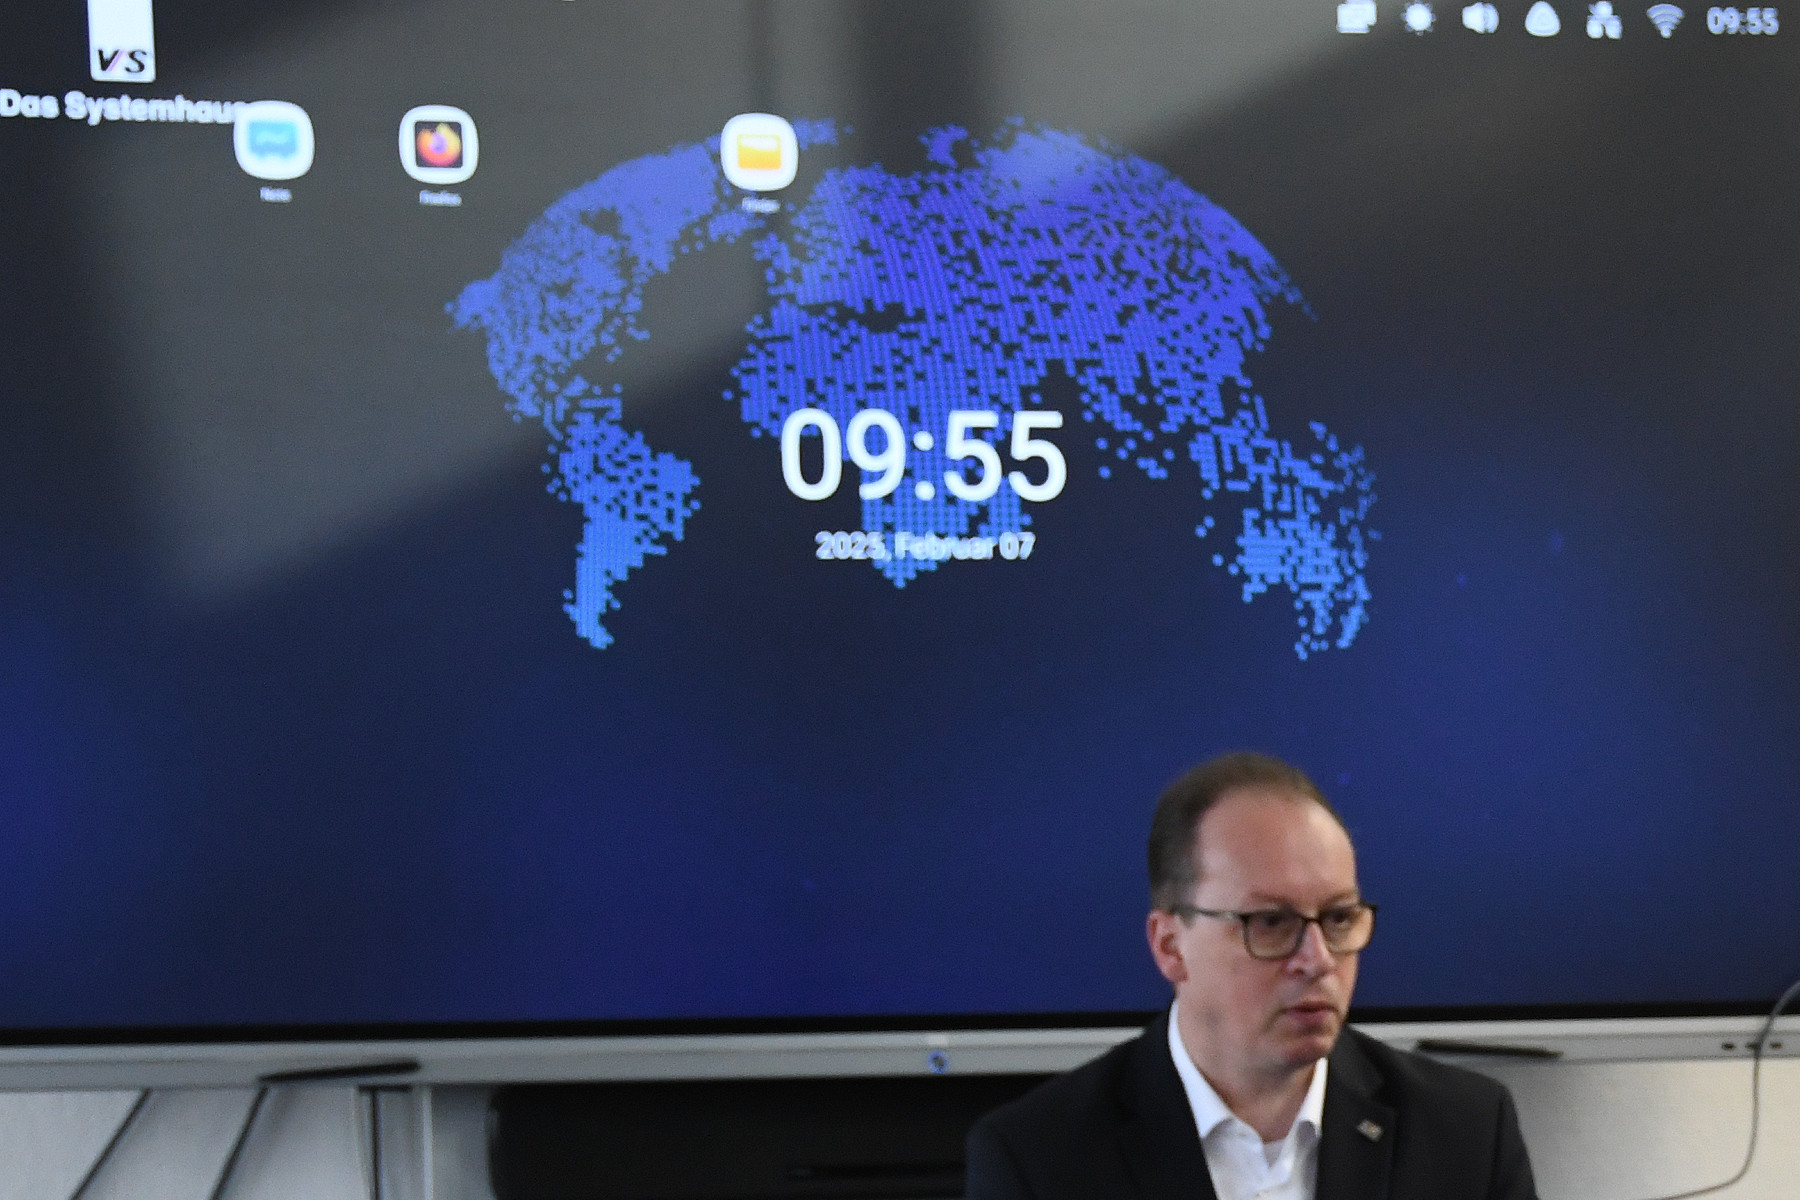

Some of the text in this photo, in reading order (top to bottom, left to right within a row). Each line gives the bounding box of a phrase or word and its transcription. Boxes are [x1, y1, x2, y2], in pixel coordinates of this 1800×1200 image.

[1707, 6, 1779, 35] 09:55
[0, 89, 59, 119] Das
[781, 408, 1067, 502] 09:55
[895, 531, 998, 560] Februar
[1000, 531, 1036, 560] 07
